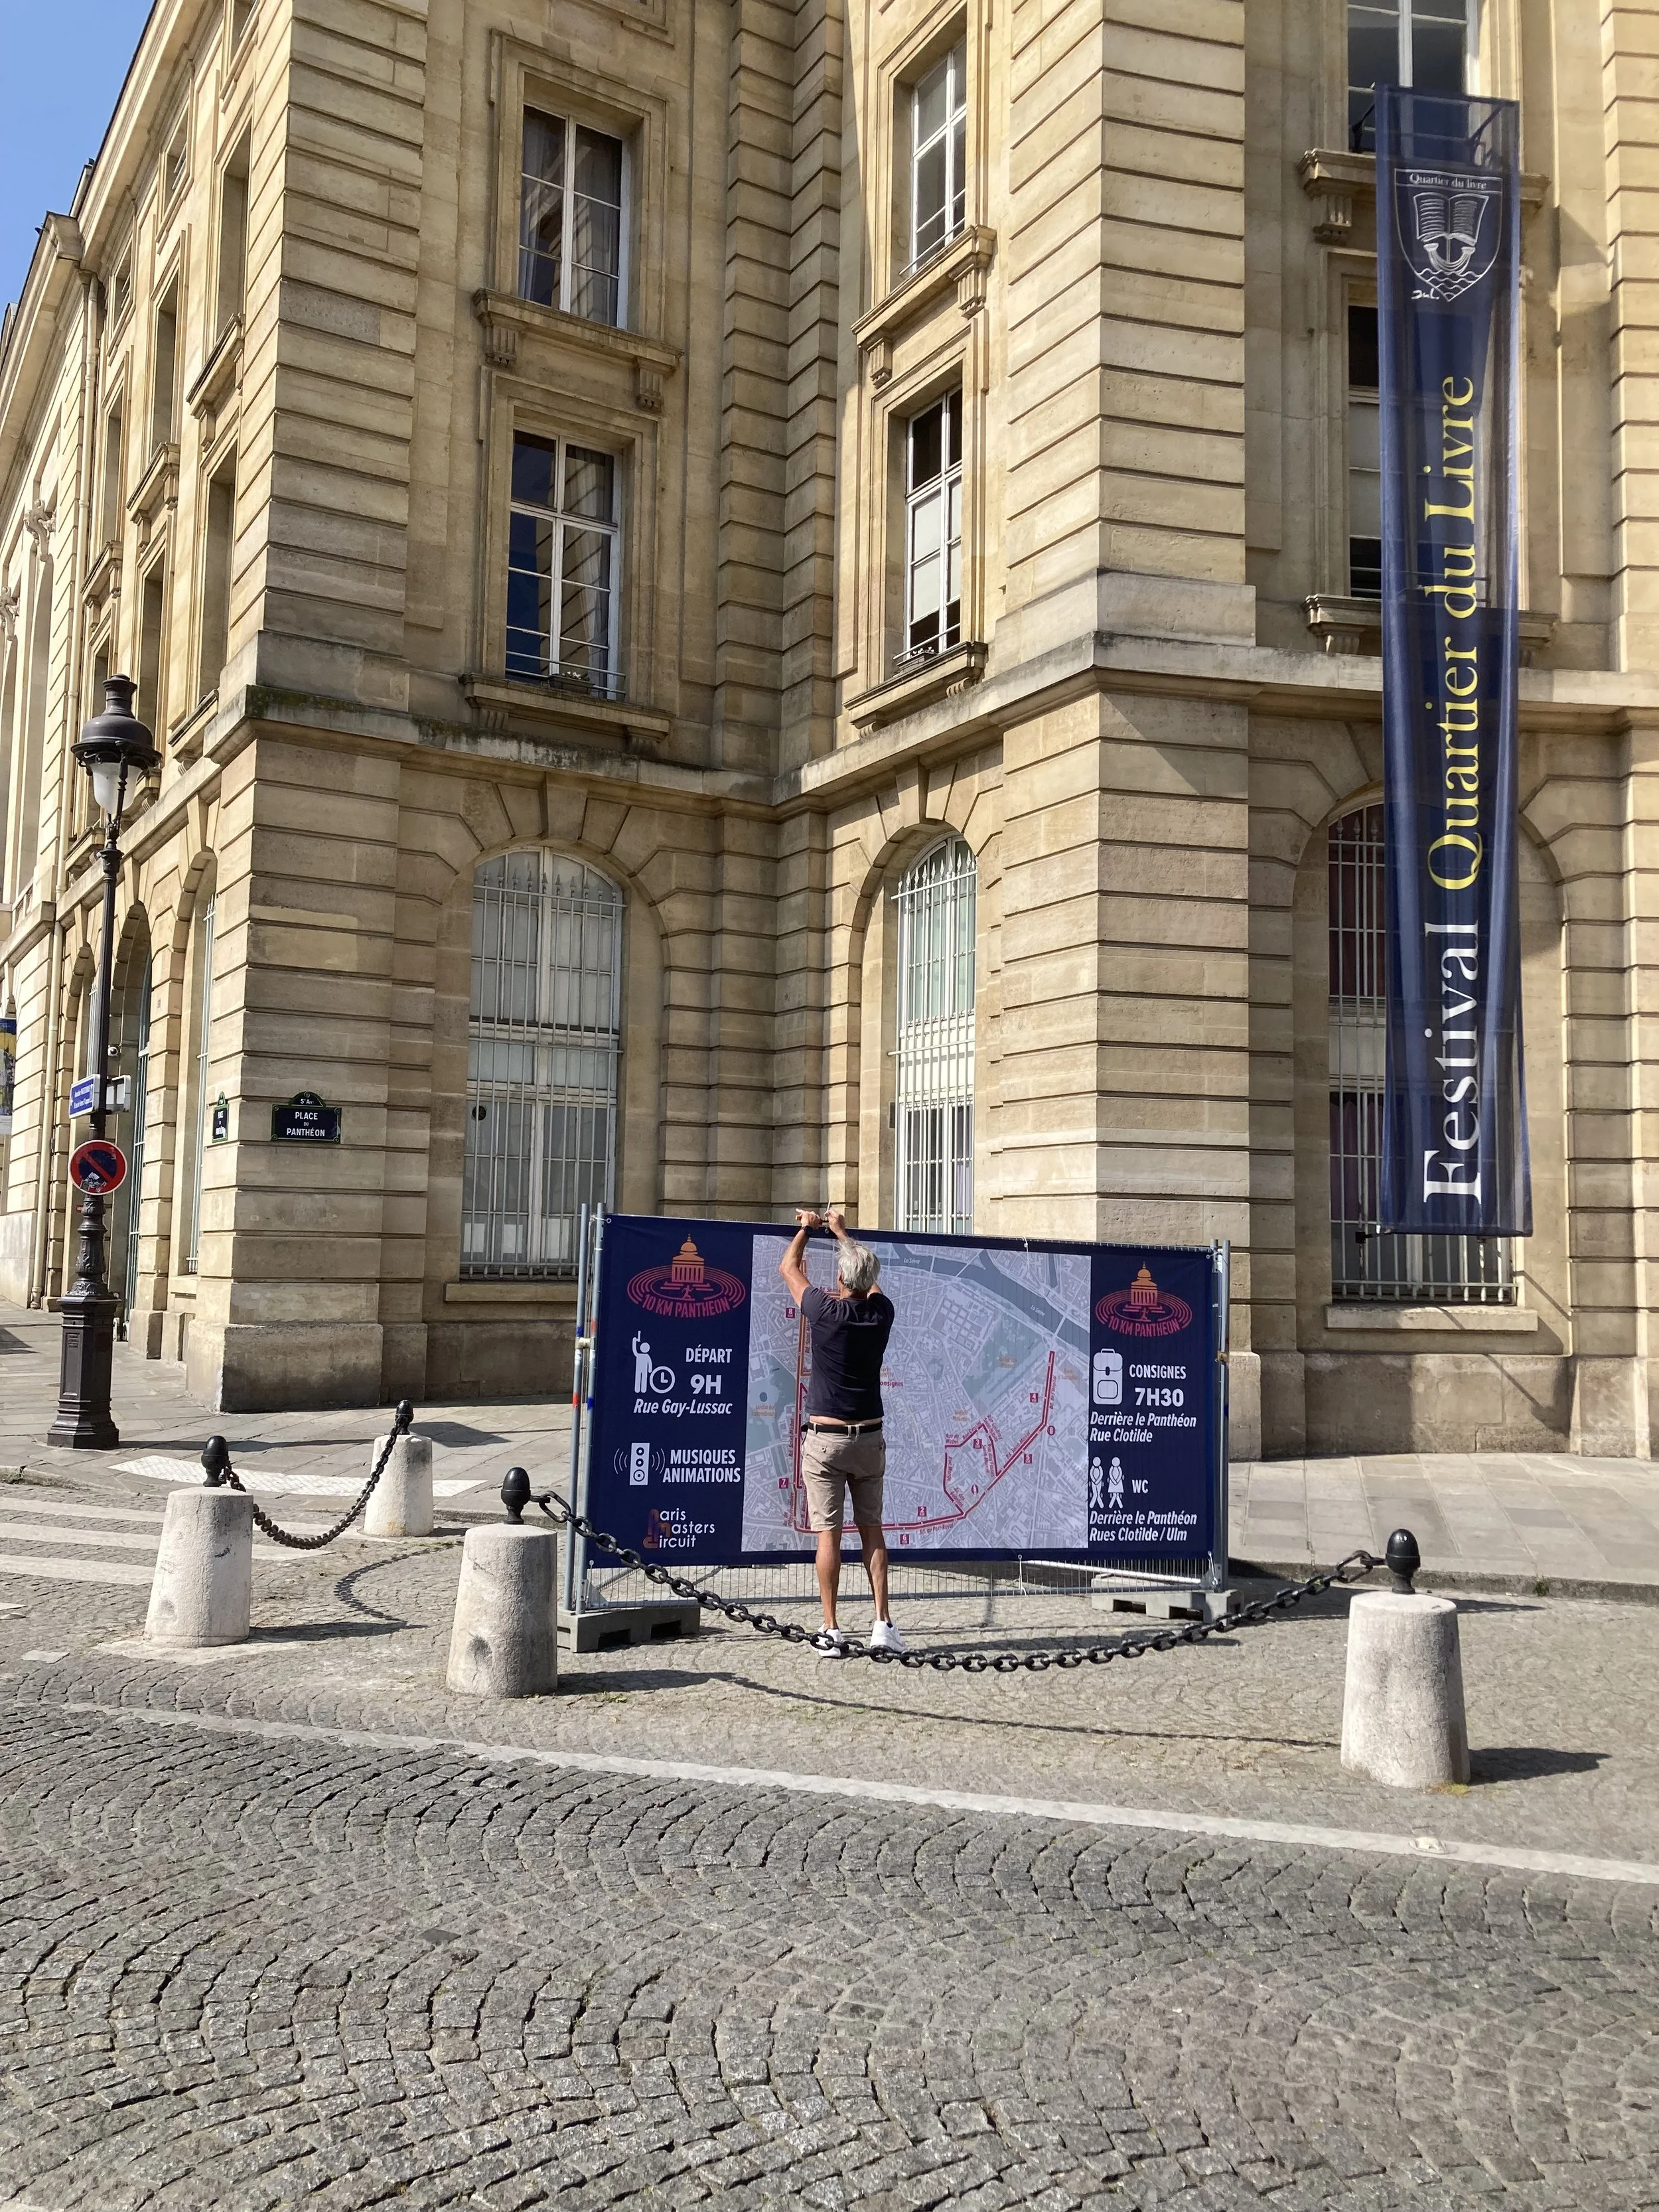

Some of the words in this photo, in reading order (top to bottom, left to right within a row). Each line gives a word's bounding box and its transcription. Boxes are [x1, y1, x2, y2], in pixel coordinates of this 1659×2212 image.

[1409, 173, 1449, 186] Quartier
[1451, 177, 1465, 188] du
[1467, 177, 1487, 190] livre
[1425, 376, 1475, 522] Livre
[1425, 544, 1480, 618] du
[1427, 636, 1481, 891] Quartier
[1423, 922, 1482, 1205] Festival
[295, 1112, 319, 1120] PLACE
[286, 1127, 325, 1137] PANTHÉON
[642, 1294, 656, 1310] 10
[656, 1297, 673, 1316] KM
[674, 1296, 731, 1318] PANTHEON
[1108, 1316, 1119, 1329] 10
[1120, 1319, 1133, 1336] KM
[1135, 1318, 1180, 1337] PANTHEON
[685, 1344, 733, 1363] DÉPART
[1129, 1364, 1187, 1379] CONSIGNES
[690, 1374, 722, 1394] 9H
[1135, 1388, 1184, 1407] 7H30
[633, 1398, 659, 1414] Rue
[662, 1398, 733, 1418] Gay-Lussac
[1090, 1411, 1133, 1426] Derrière
[1135, 1412, 1145, 1426] le
[1147, 1413, 1196, 1427] Panthéon
[1090, 1428, 1111, 1441] Rue
[1113, 1428, 1153, 1442] Clotilde
[670, 1449, 736, 1465] MUSIQUES
[663, 1467, 741, 1483] ANIMATIONS
[1132, 1479, 1149, 1493] WC
[1090, 1511, 1133, 1524] Derrière
[1135, 1511, 1145, 1524] le
[1147, 1511, 1197, 1524] Panthéon
[1090, 1527, 1116, 1541] Rues
[1118, 1527, 1159, 1541] Clotilde
[1159, 1527, 1166, 1541] /
[1167, 1527, 1187, 1541] Ulm
